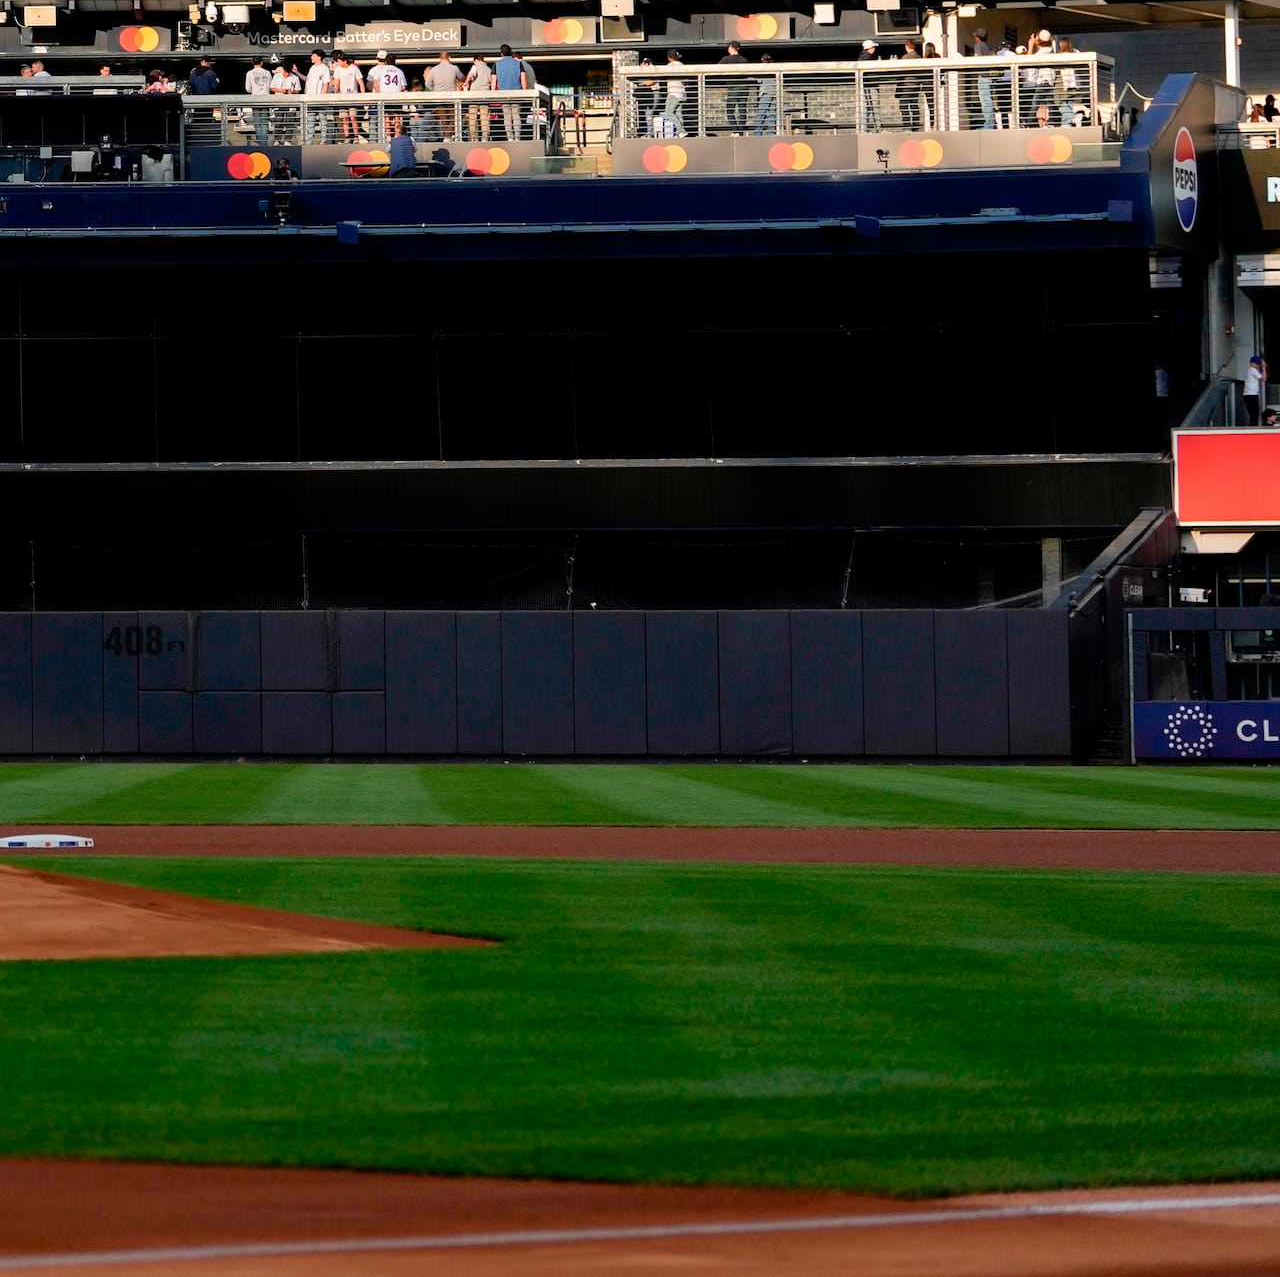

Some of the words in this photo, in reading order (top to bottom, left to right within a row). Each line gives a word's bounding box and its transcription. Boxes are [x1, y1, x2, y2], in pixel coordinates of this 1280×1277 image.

[246, 30, 331, 44] Mastercard
[336, 29, 391, 43] Batter's
[394, 29, 421, 44] Eye
[422, 28, 458, 43] Deck
[1175, 167, 1196, 192] PEPSI
[105, 625, 163, 656] 408
